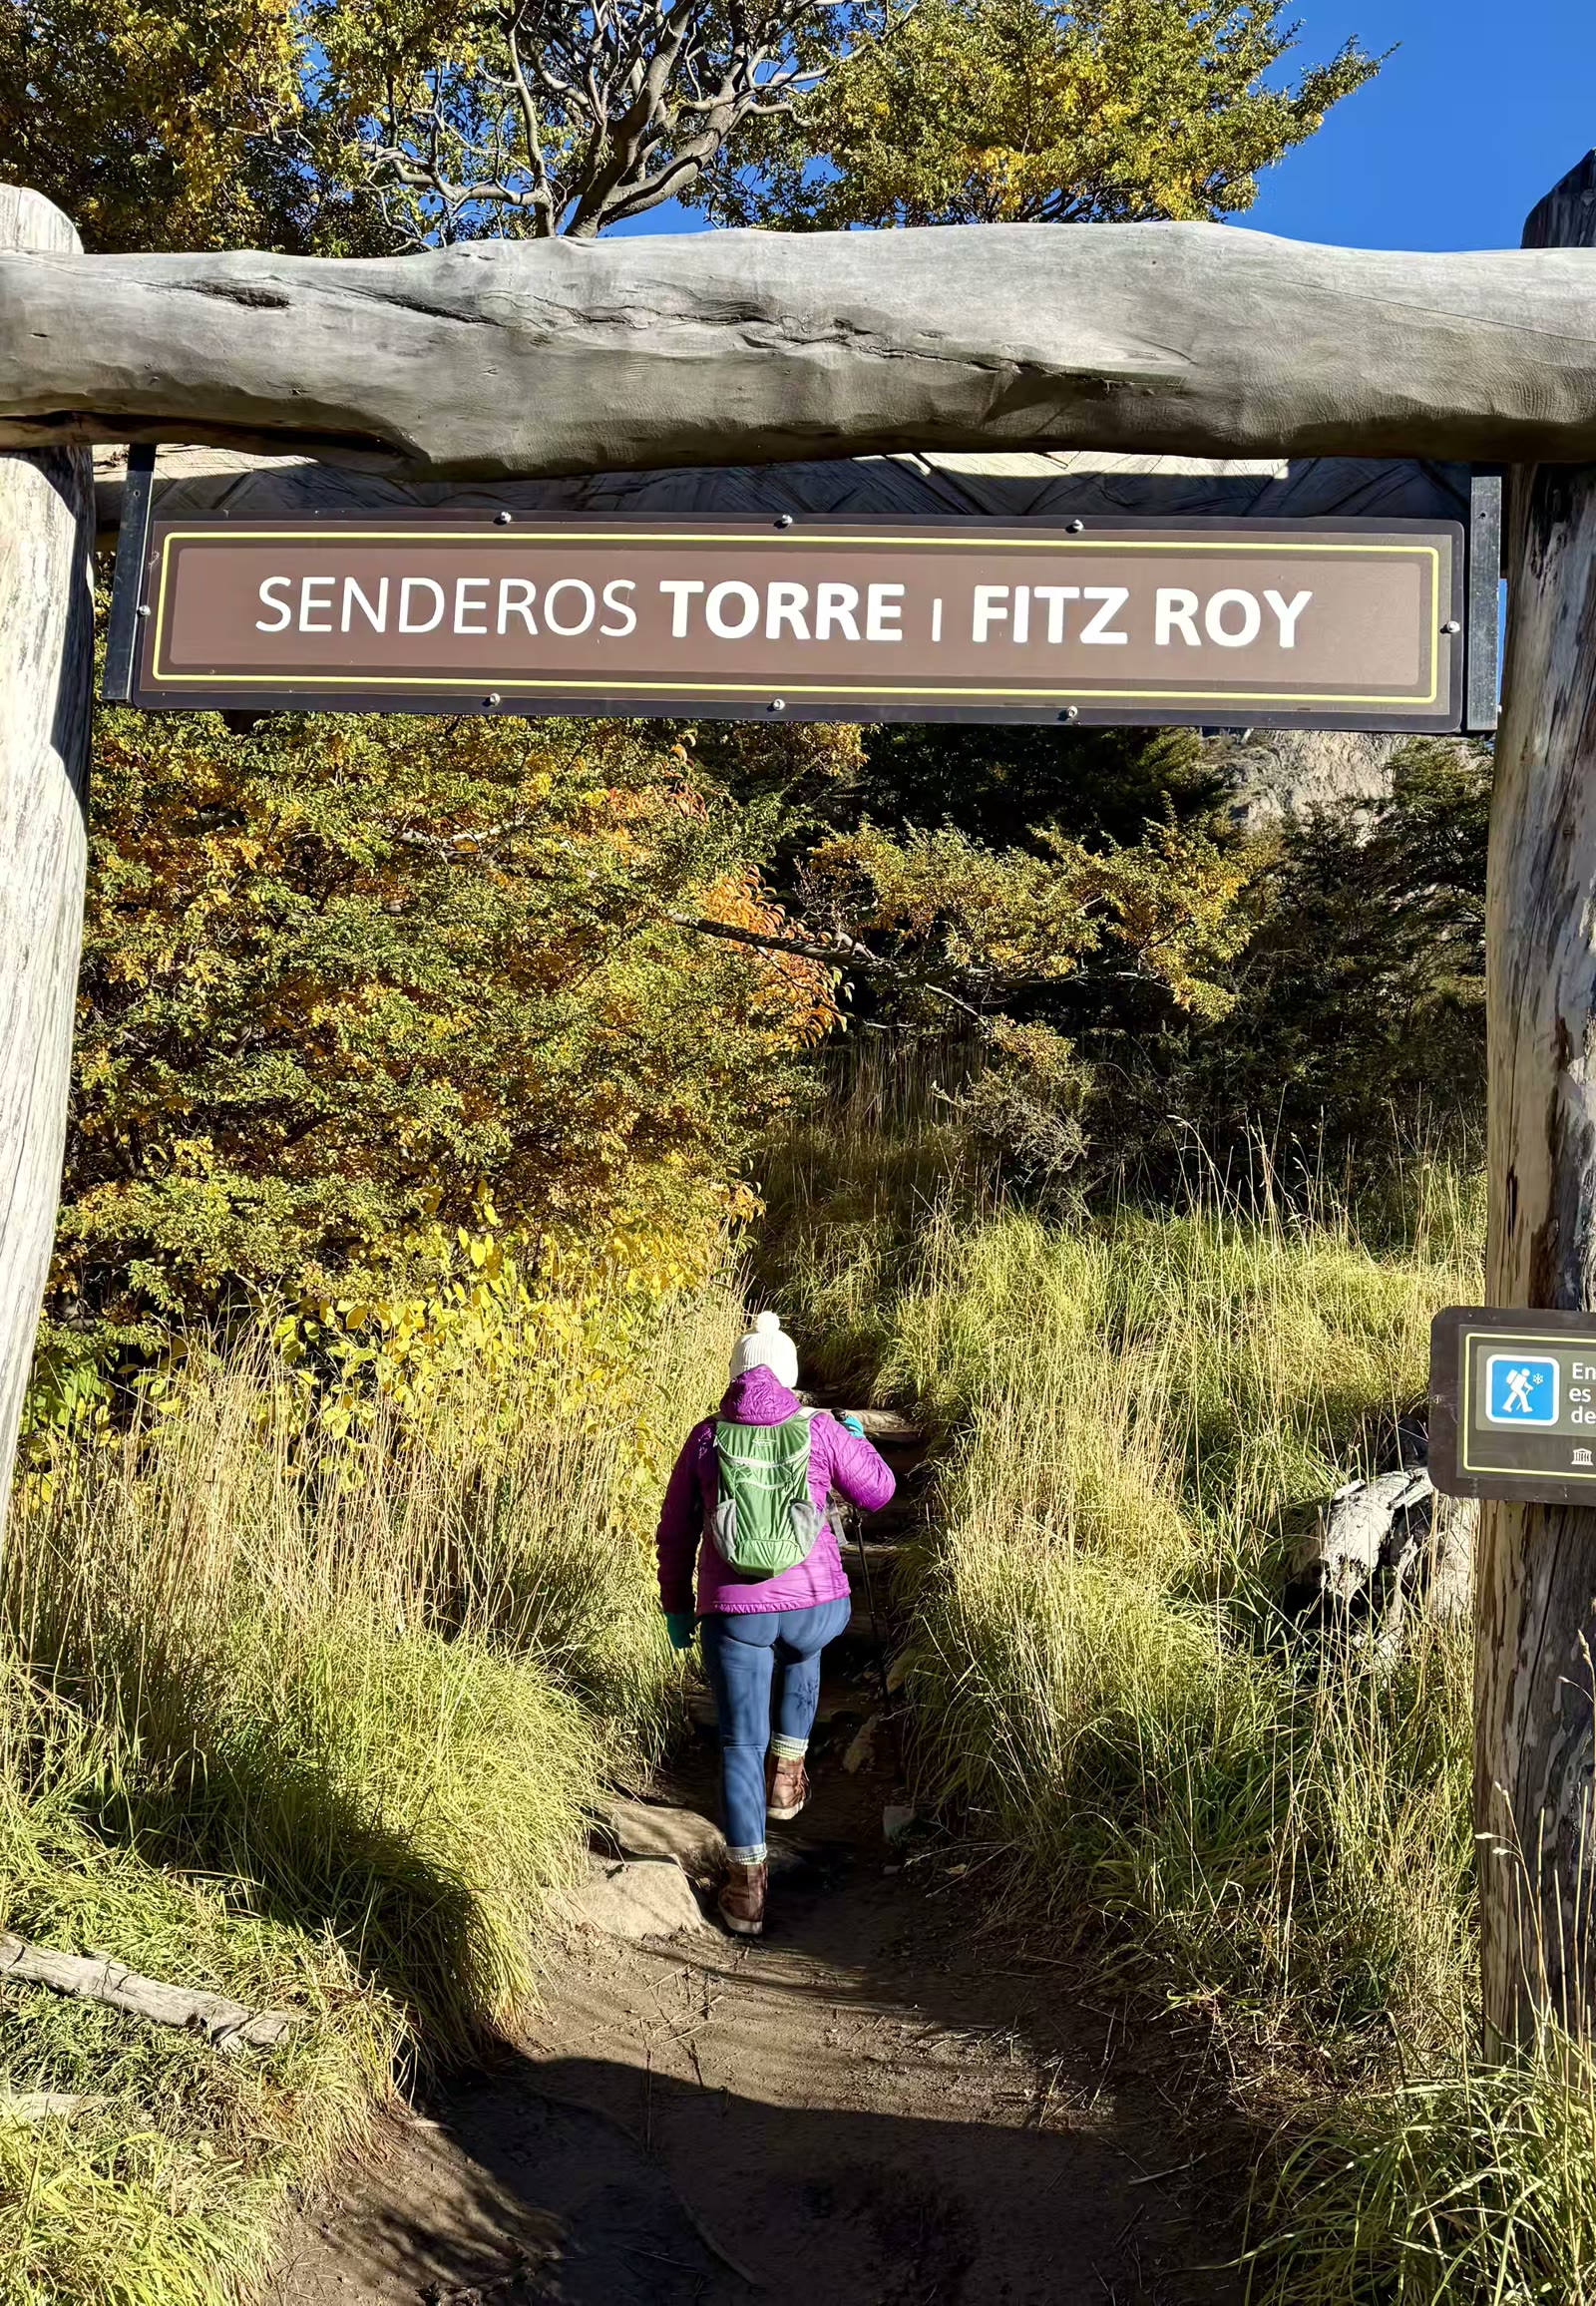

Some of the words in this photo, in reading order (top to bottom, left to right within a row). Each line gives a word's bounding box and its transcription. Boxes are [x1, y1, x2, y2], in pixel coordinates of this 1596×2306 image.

[255, 576, 637, 637] SENDEROS
[659, 579, 906, 641] TORRE
[972, 584, 1130, 645] FITZ
[1154, 587, 1314, 648] ROY
[1568, 1387, 1592, 1402] es
